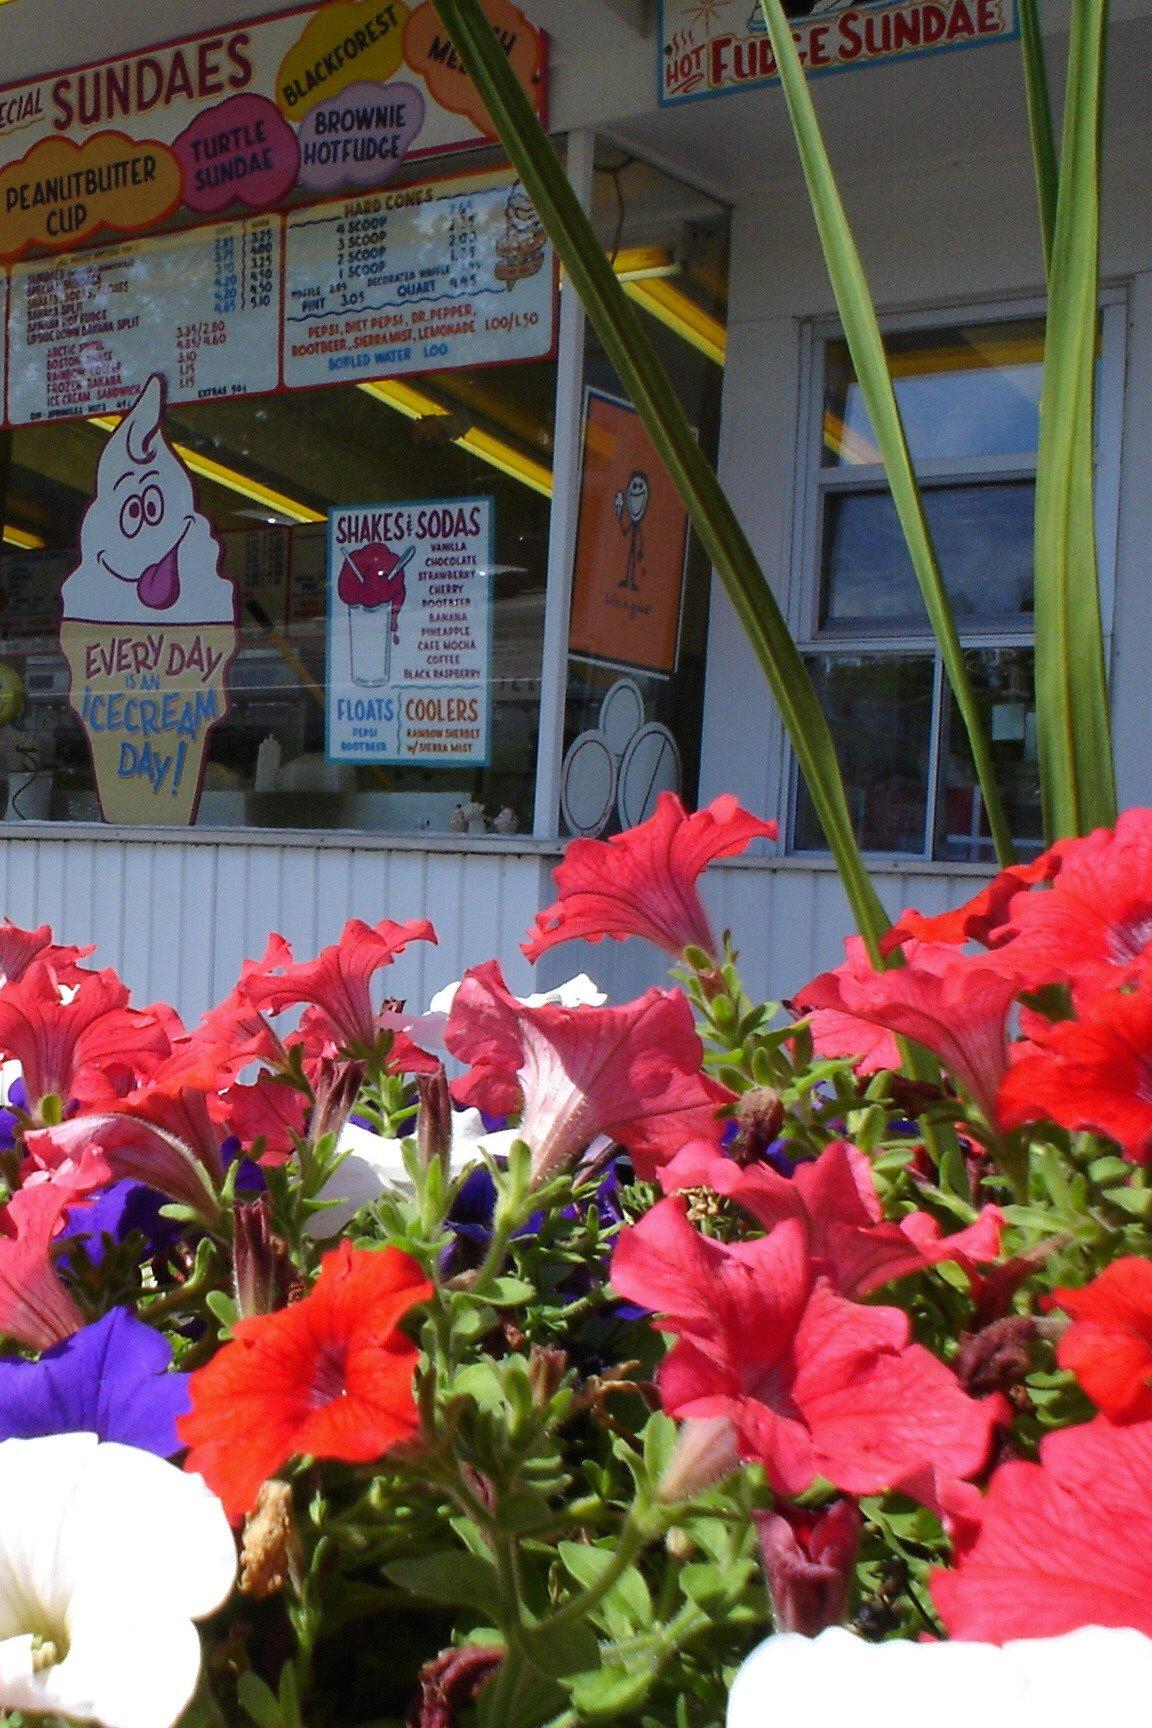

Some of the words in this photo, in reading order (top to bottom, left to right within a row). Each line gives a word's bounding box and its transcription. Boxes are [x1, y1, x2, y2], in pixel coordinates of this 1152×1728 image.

[666, 45, 705, 87] HOT
[837, 0, 1002, 60] SUNDAE
[281, 4, 398, 106] BLACKFOREST
[51, 32, 252, 131] SUNDAES
[315, 103, 405, 134] BROWNIE
[191, 120, 265, 161] TURTLE
[303, 135, 400, 165] HOTFUDGE
[194, 149, 272, 192] SUNDAE
[4, 155, 156, 212] PEANUTBUTTER
[344, 198, 381, 218] HARD
[46, 203, 87, 237] CUP
[347, 216, 388, 234] SCOOP
[348, 231, 387, 249] SCOOP
[336, 252, 344, 265] 2
[348, 245, 387, 263] SCOOP
[347, 260, 387, 278] SCOOP
[396, 279, 435, 298] QUART
[335, 510, 404, 544] SHAKES
[415, 505, 481, 540] SODAS
[430, 541, 466, 553] VANILLA
[425, 555, 477, 567] CHOCOLATE
[418, 568, 476, 580] STRAWBERRY
[428, 584, 463, 595] CHERRY
[428, 611, 467, 622] BANANA
[420, 626, 470, 637] PINEAPPLE
[417, 641, 440, 651] CAFE
[442, 639, 476, 650] MOCHA
[85, 634, 163, 678] EVERY
[165, 635, 222, 682] DAY
[426, 654, 461, 665] COFFEE
[125, 673, 135, 688] IS
[140, 673, 159, 689] AN
[403, 668, 430, 679] BLACK
[432, 669, 480, 679] RASPBERRY
[336, 698, 394, 721] FLOATS
[405, 697, 478, 722] COOLERS
[352, 727, 377, 737] PEPSI
[406, 728, 443, 738] RAINBOW
[444, 728, 480, 739] SHERBET
[419, 742, 448, 752] SIERRA
[118, 740, 187, 795] DAY!
